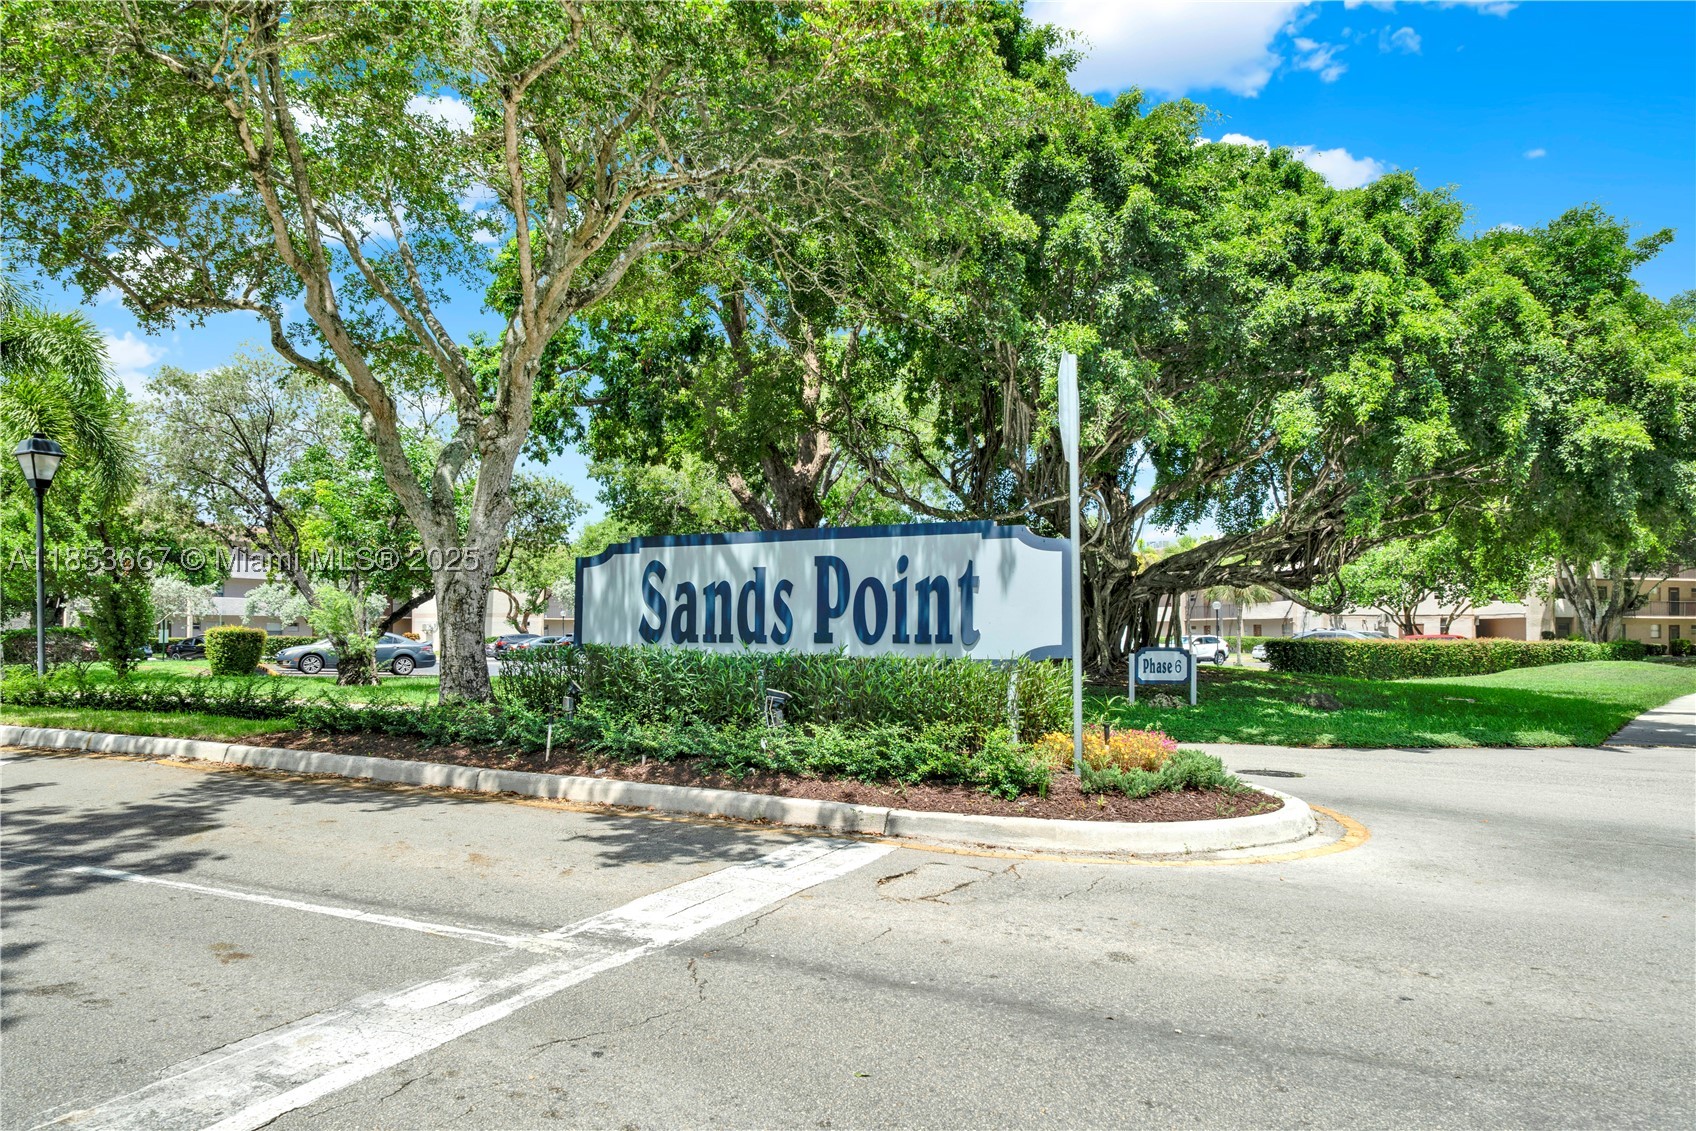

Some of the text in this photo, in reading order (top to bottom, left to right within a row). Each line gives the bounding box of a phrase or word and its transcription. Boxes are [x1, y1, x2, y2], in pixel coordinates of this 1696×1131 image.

[638, 554, 981, 646] Sands Point
[1142, 658, 1182, 674] Phase 6
